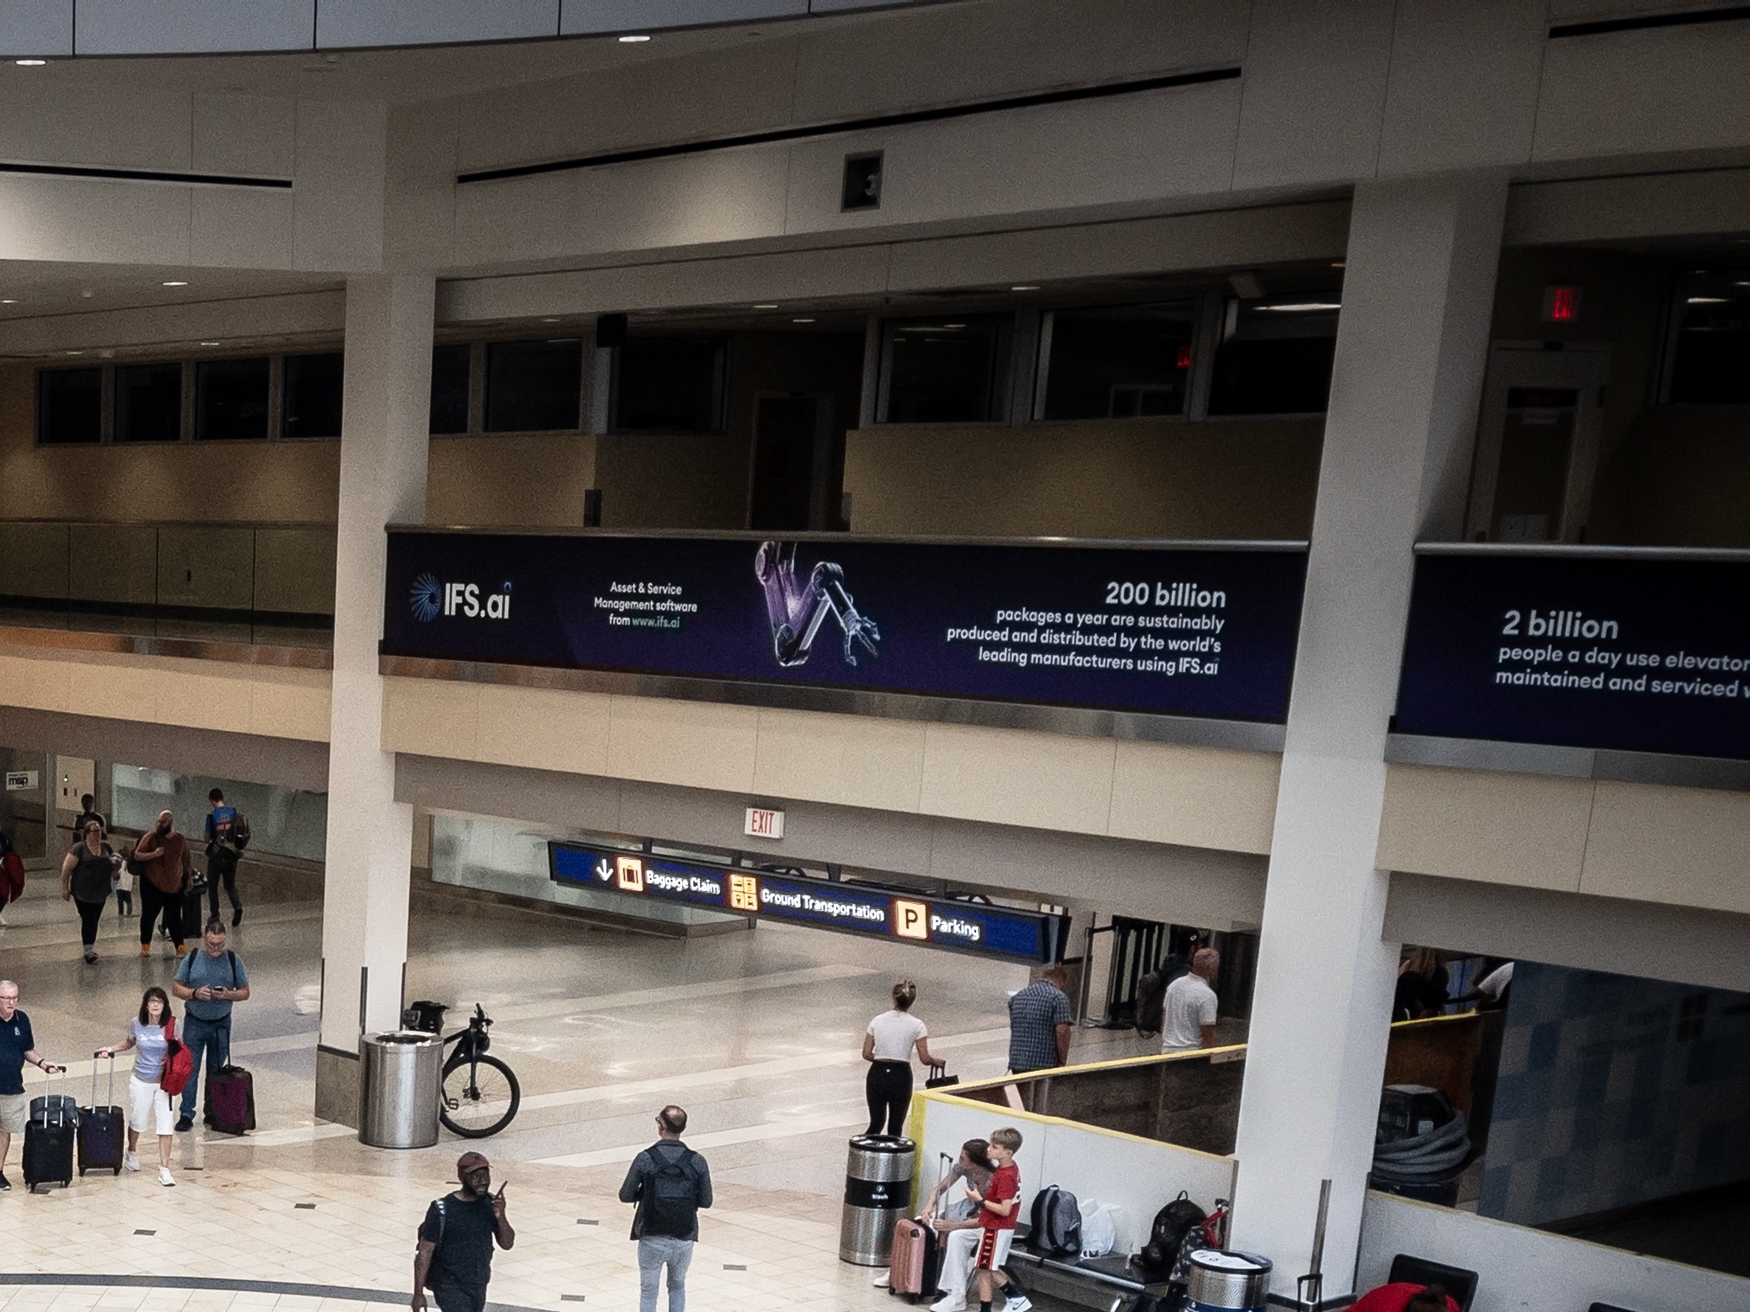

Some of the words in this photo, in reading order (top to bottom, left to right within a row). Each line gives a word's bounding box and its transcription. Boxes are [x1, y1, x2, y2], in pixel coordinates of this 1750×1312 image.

[444, 580, 512, 620] IFS.ai
[610, 580, 636, 594] Asset
[638, 582, 646, 594] &
[648, 582, 682, 596] Service
[1105, 581, 1150, 605] 200
[1155, 582, 1227, 608] billion
[594, 597, 654, 613] Management
[655, 598, 698, 613] software
[608, 613, 631, 627] from
[631, 615, 680, 629] www.ifs.ai
[996, 607, 1062, 626] packages
[1065, 613, 1074, 624] a
[1076, 613, 1109, 628] year
[1110, 614, 1135, 626] are
[1138, 613, 1225, 634] sustainably
[1502, 610, 1521, 636] 2
[1528, 609, 1619, 639] billion
[947, 626, 1009, 642] produced
[1011, 629, 1038, 643] and
[1040, 629, 1117, 648] distributed
[1119, 632, 1138, 651] by
[1140, 634, 1165, 650] the
[978, 646, 1028, 666] leading
[1030, 651, 1134, 670] manufacturers
[1137, 656, 1176, 676] using
[1178, 657, 1220, 675] IFS.ai
[1498, 644, 1563, 665] people
[1568, 649, 1580, 663] a
[1585, 647, 1622, 668] day
[1626, 652, 1661, 667] use
[1495, 668, 1604, 689] maintained
[1609, 675, 1647, 692] and
[1651, 678, 1739, 698] serviced
[750, 808, 775, 835] EXIT
[645, 868, 689, 892] Baggage
[689, 872, 721, 895] Claim
[761, 887, 801, 909] Ground
[802, 893, 885, 922] Transportation
[904, 906, 919, 930] P
[930, 914, 981, 942] Parking
